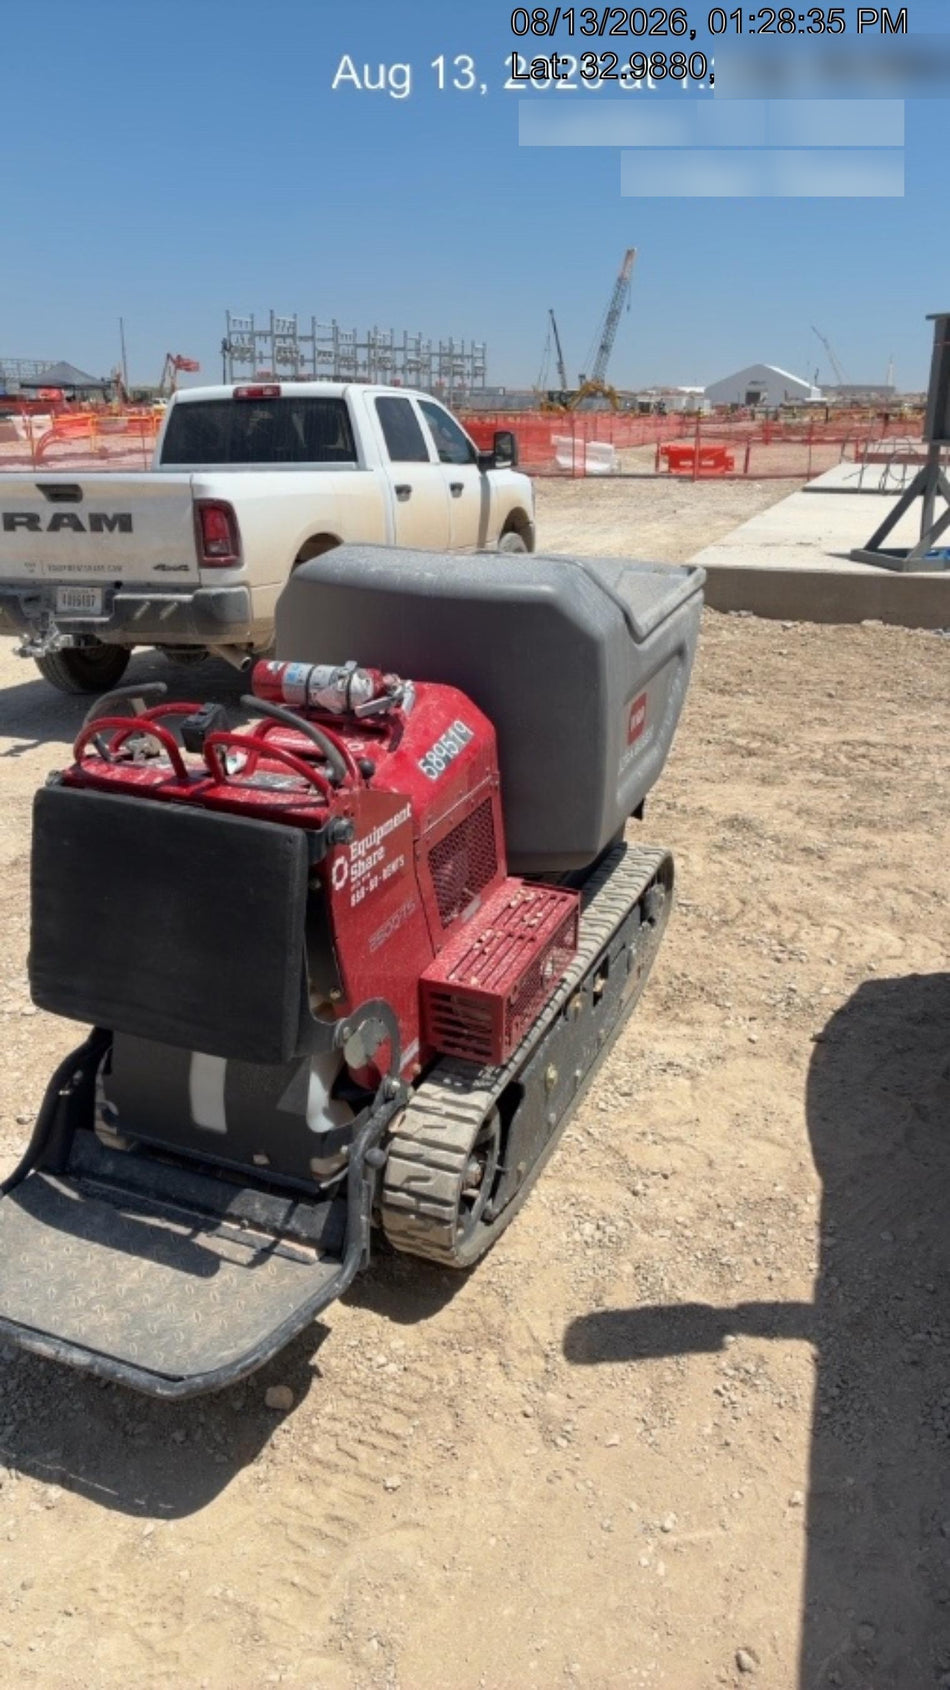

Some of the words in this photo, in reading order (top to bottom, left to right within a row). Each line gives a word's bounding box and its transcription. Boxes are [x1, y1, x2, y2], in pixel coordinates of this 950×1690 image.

[2, 512, 134, 533] RAM
[418, 719, 475, 781] 589519
[350, 802, 412, 861] Equipment
[350, 846, 386, 882] Share
